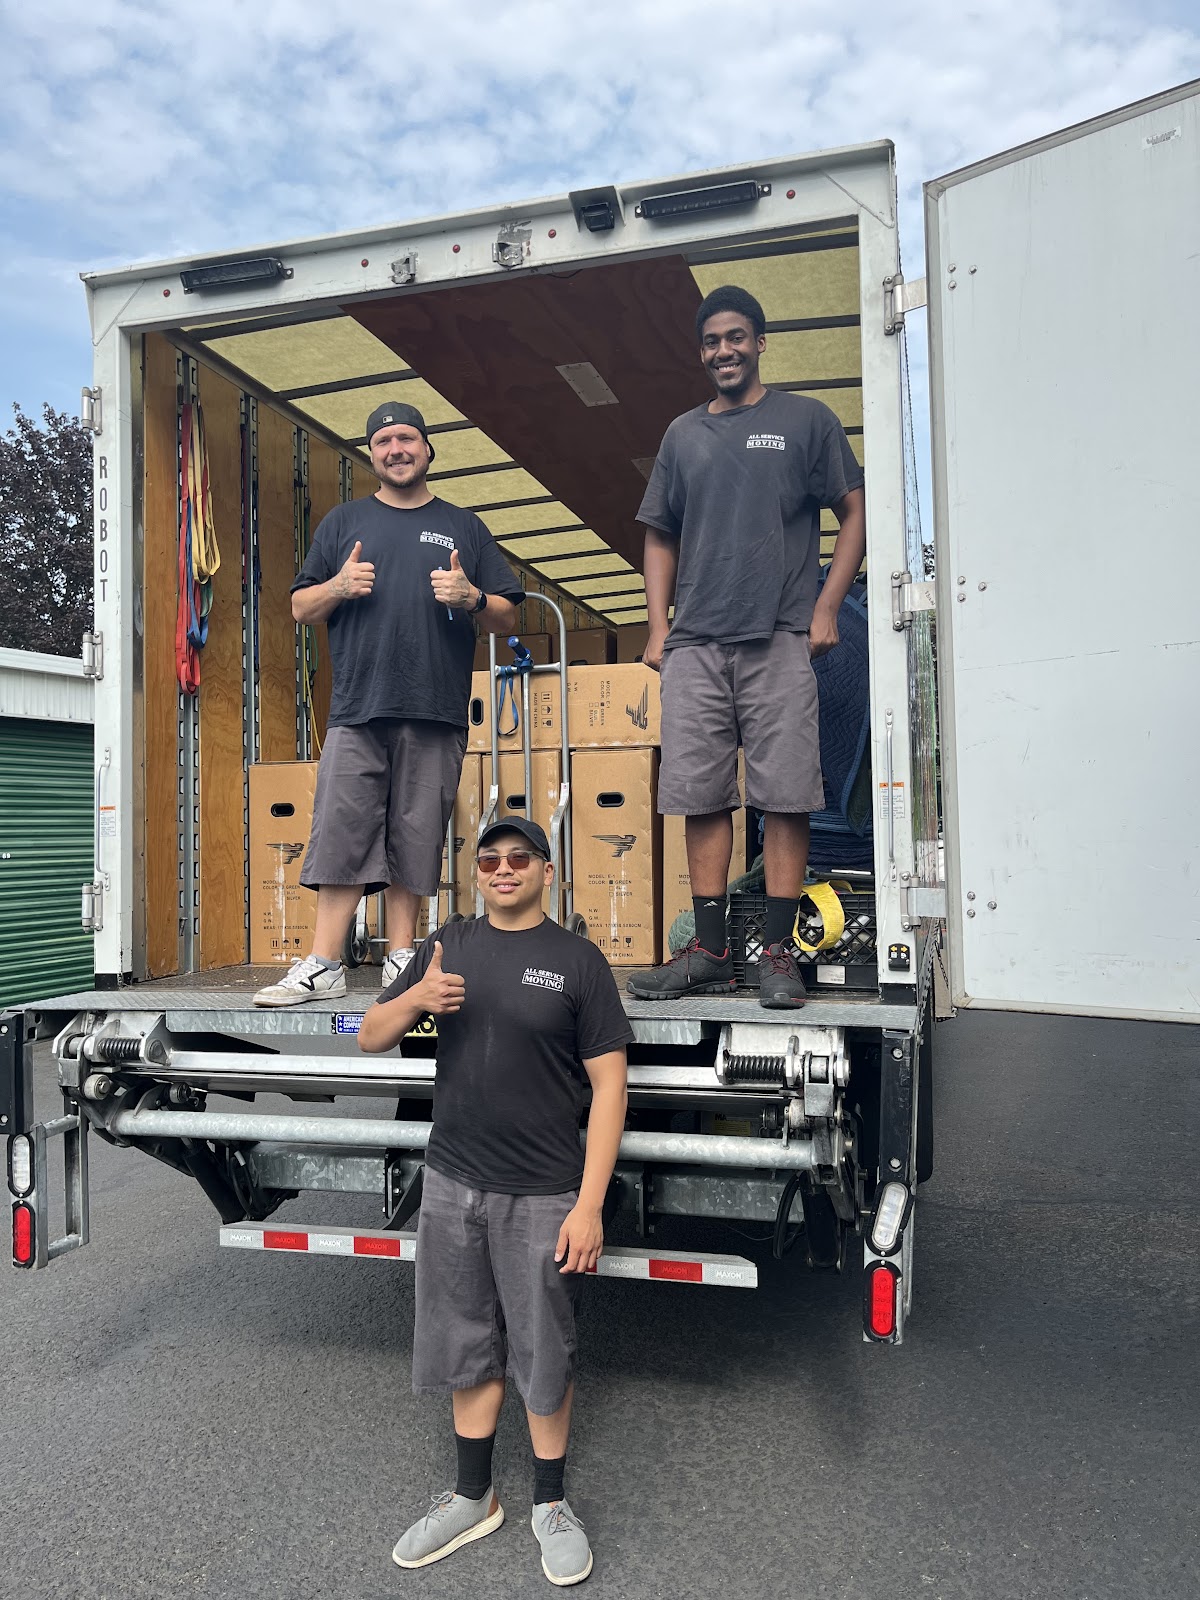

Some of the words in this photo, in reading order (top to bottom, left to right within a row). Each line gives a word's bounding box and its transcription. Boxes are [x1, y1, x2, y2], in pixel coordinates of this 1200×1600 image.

[760, 434, 785, 442] SERVICE
[748, 440, 785, 449] MOVING
[99, 455, 108, 602] ROBOT
[420, 535, 454, 549] MOVING
[432, 532, 454, 543] SERVICE
[524, 967, 537, 975] ALL
[537, 969, 566, 981] SERVICE
[524, 975, 562, 989] MOVING
[230, 1234, 252, 1242] MAXON
[274, 1236, 297, 1244] MAXON
[319, 1239, 341, 1247] MAXON
[365, 1242, 388, 1250] MAXON
[609, 1262, 635, 1270] MAXON
[662, 1266, 688, 1275] MAXON
[715, 1270, 743, 1280] MAXON
